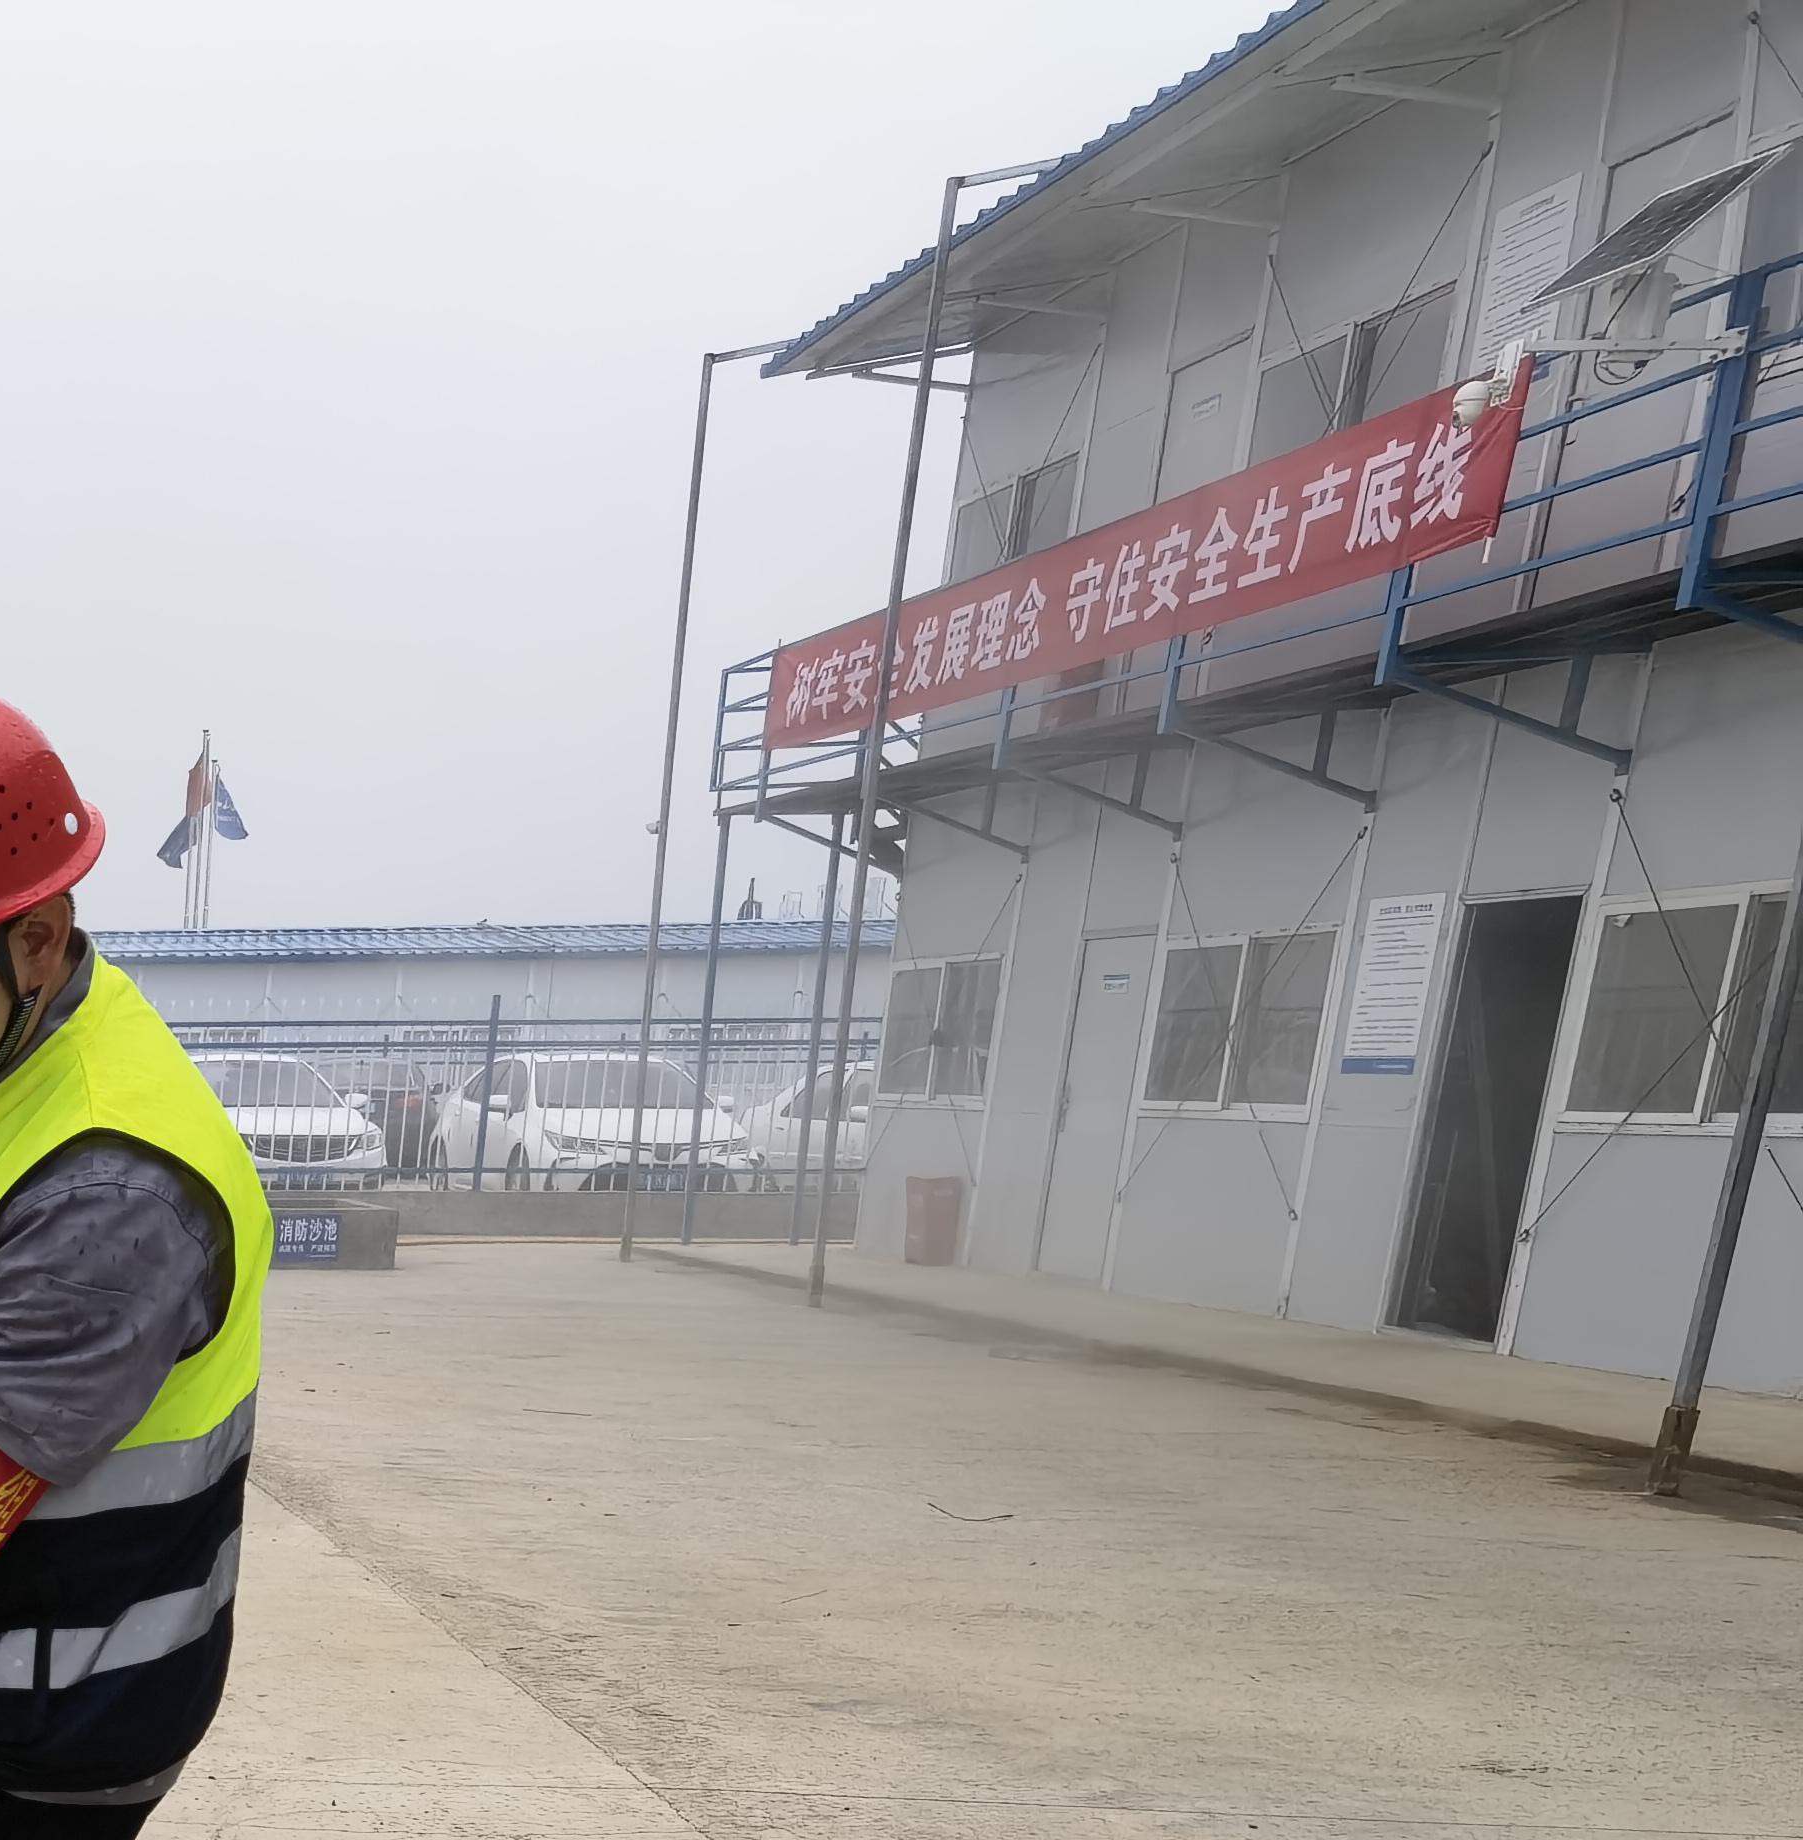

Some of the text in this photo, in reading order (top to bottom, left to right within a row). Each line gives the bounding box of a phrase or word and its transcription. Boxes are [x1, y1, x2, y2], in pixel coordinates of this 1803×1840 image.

[1066, 422, 1474, 644] 守住安全生产底线
[280, 1217, 338, 1242] 消防沙池
